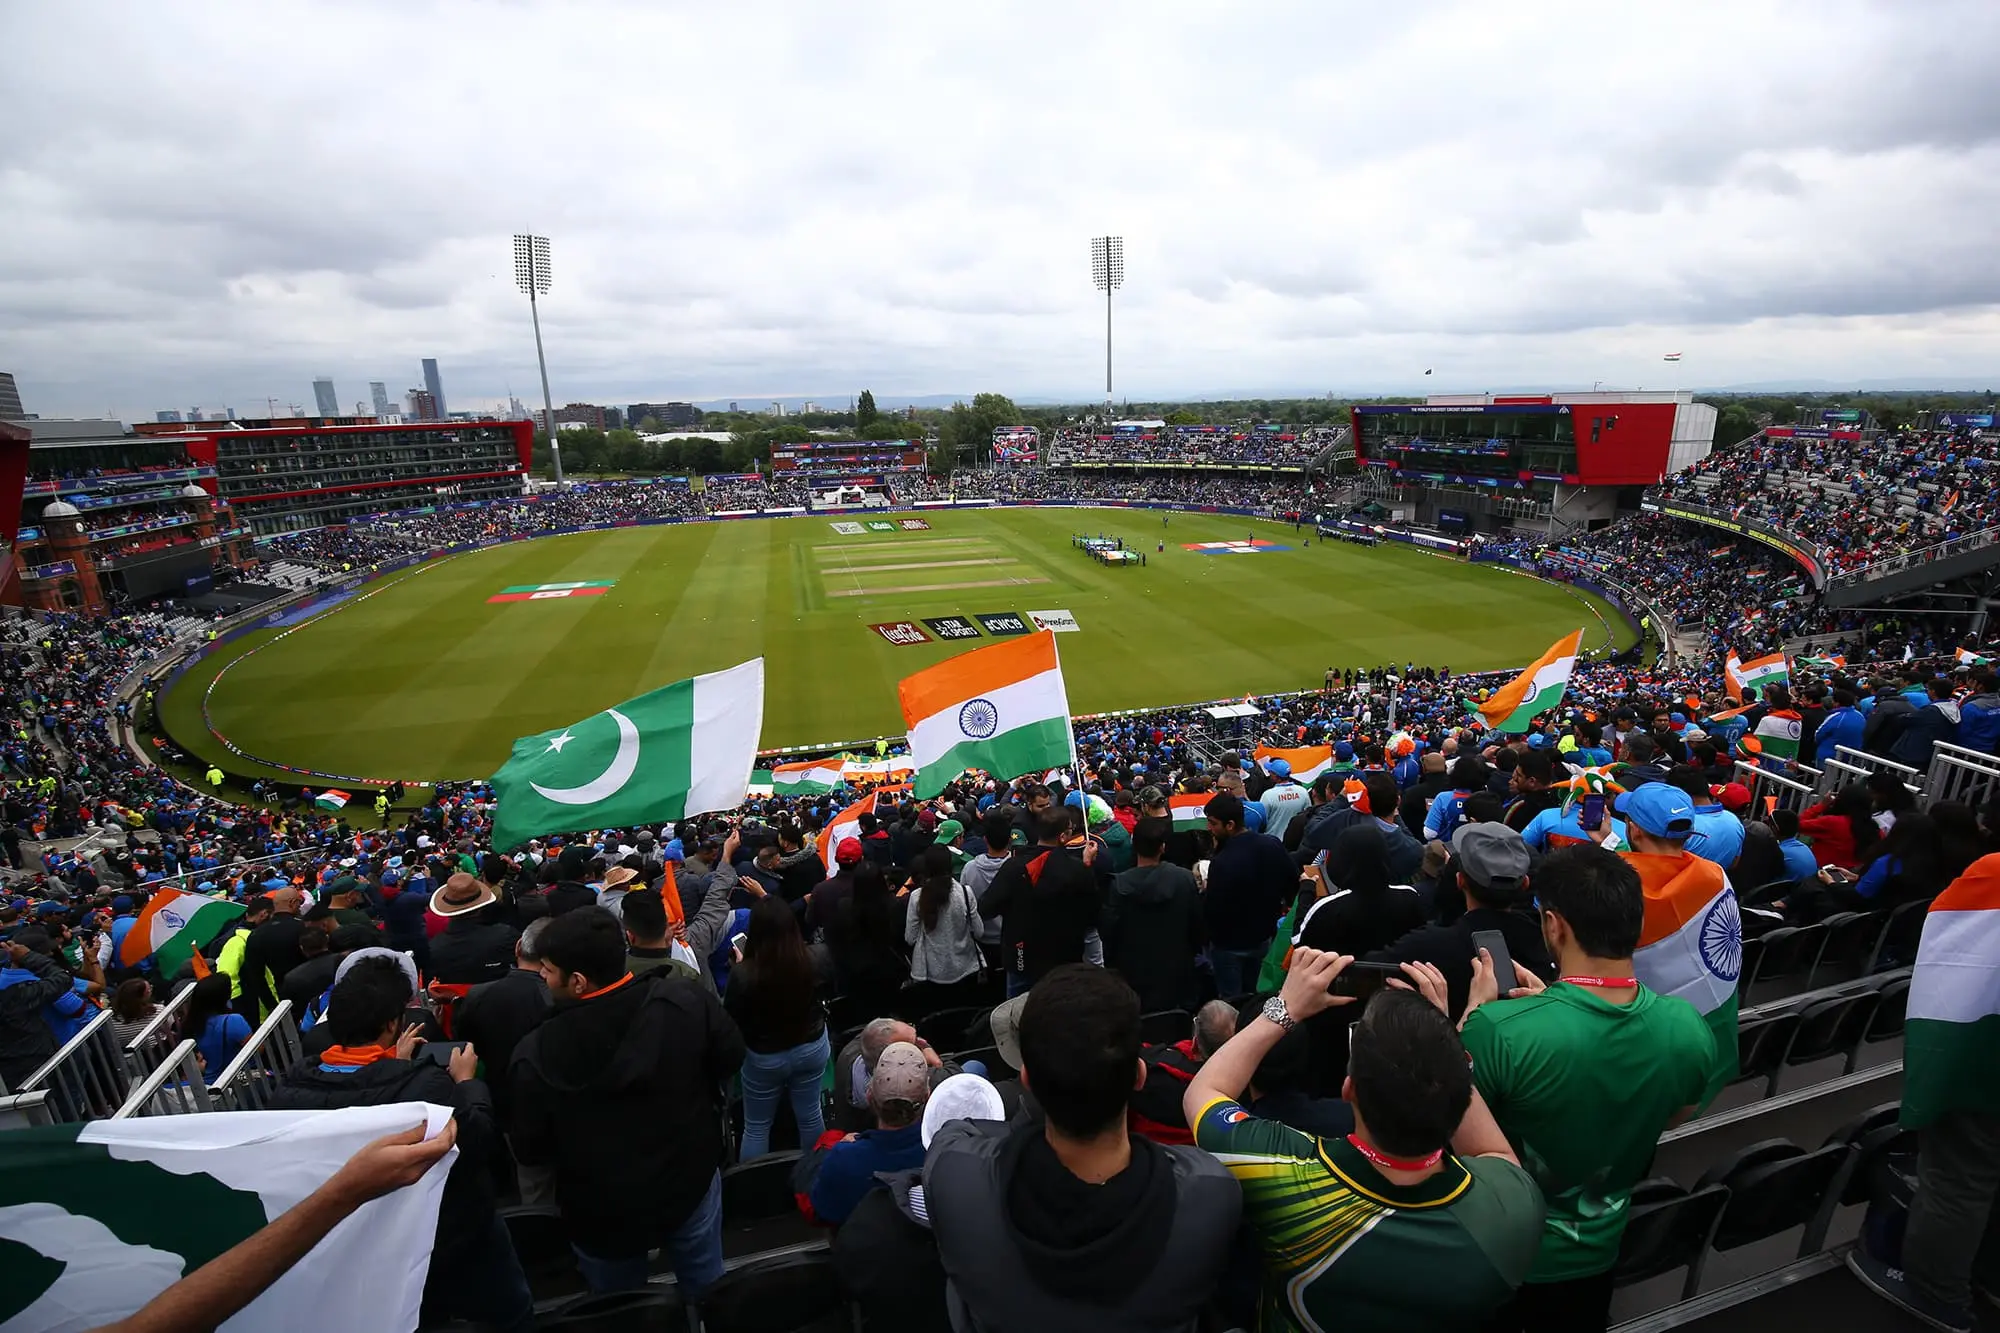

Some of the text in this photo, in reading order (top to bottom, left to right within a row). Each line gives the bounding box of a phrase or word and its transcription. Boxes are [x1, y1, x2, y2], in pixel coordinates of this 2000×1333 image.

[1411, 536, 1438, 549] PAKISTAN
[1519, 560, 1536, 572] INDIA
[942, 619, 963, 629] STAR
[984, 618, 1024, 632] #CWC19
[950, 626, 978, 637] SPORTS
[1278, 792, 1300, 801] INDIA
